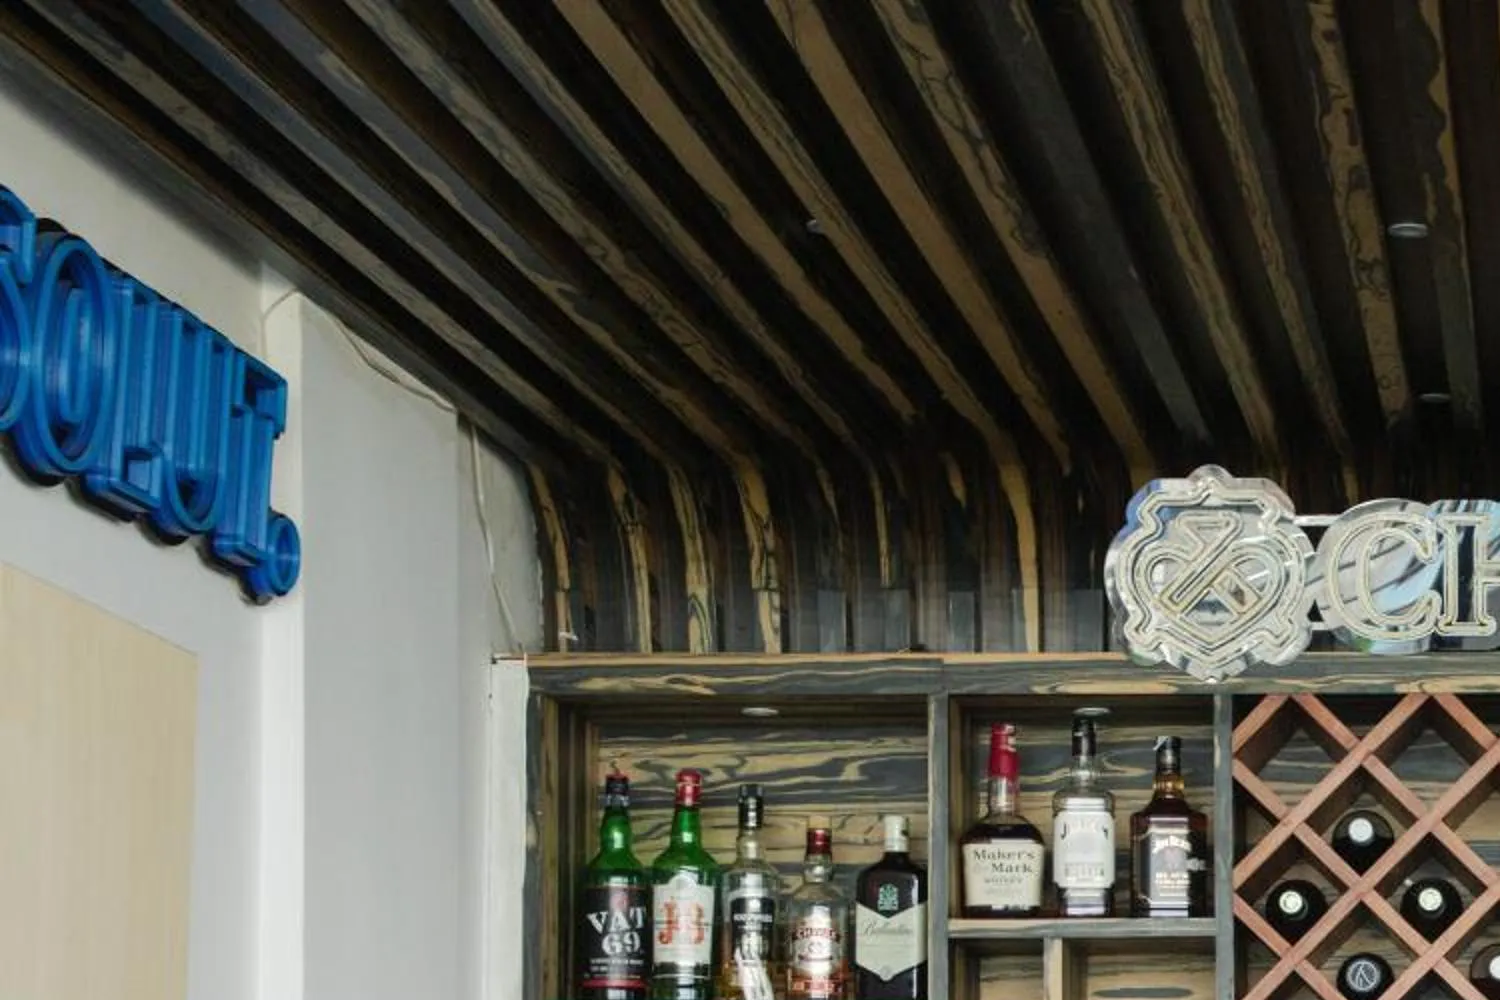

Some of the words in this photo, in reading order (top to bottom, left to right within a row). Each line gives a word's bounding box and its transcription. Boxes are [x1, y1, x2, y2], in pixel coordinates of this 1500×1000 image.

[991, 862, 1034, 873] Mark
[585, 905, 647, 935] VAT
[602, 931, 641, 956] 69
